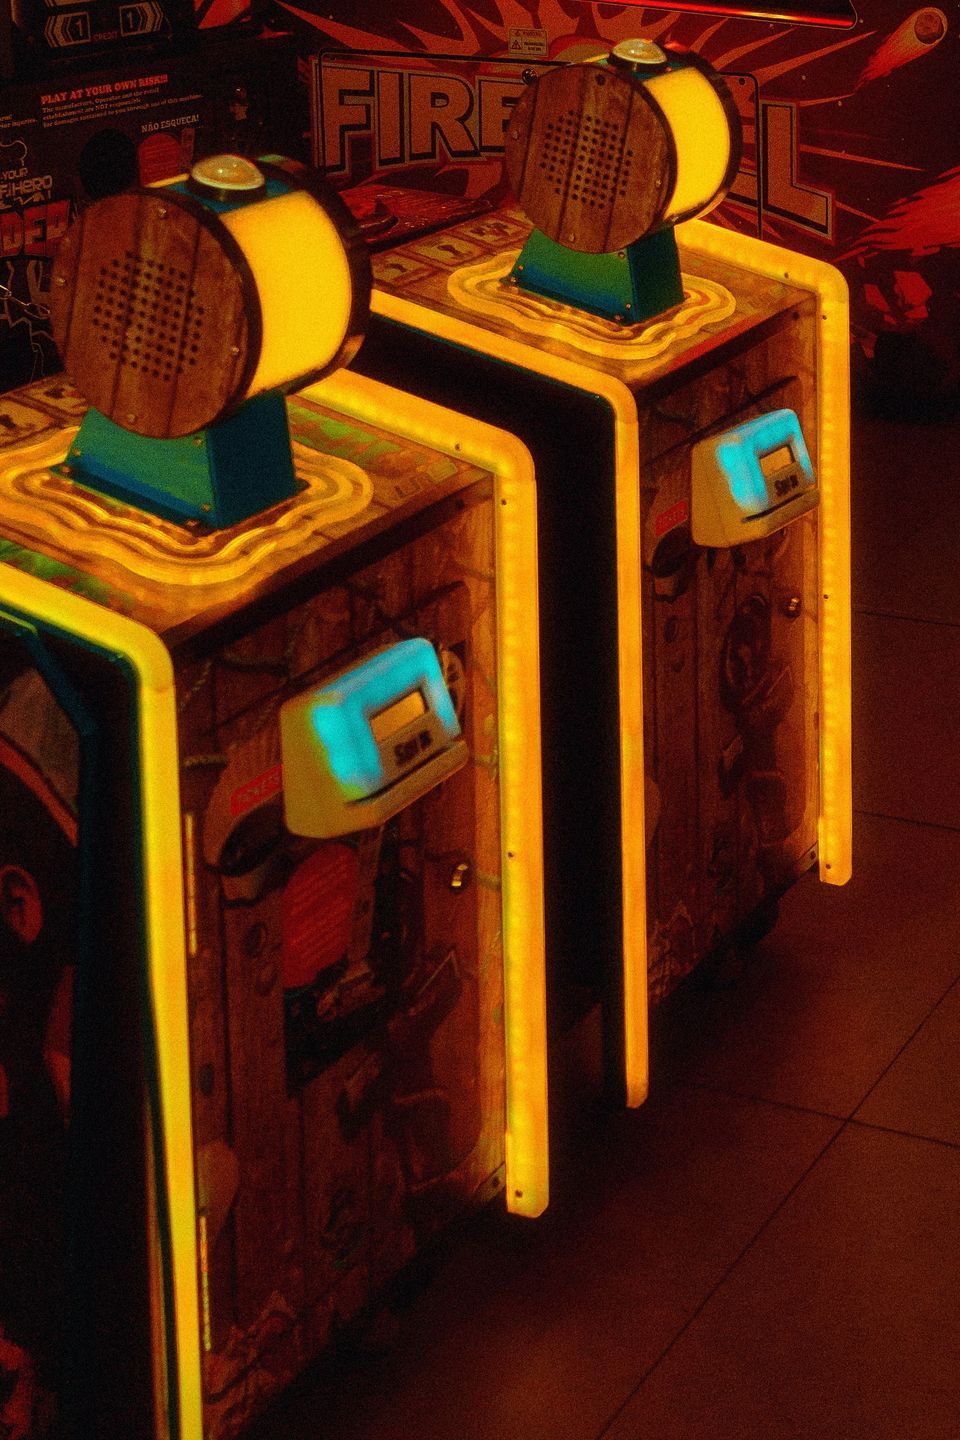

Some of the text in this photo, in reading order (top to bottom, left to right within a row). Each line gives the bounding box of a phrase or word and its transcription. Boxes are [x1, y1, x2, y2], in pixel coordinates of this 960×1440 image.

[75, 19, 85, 39] 1
[127, 11, 135, 30] 1
[40, 90, 67, 105] PLAY
[70, 87, 84, 100] AT
[85, 84, 112, 98] YOUR
[114, 79, 137, 92] OWN
[313, 58, 836, 242] FIREL
[0, 200, 71, 258] DER
